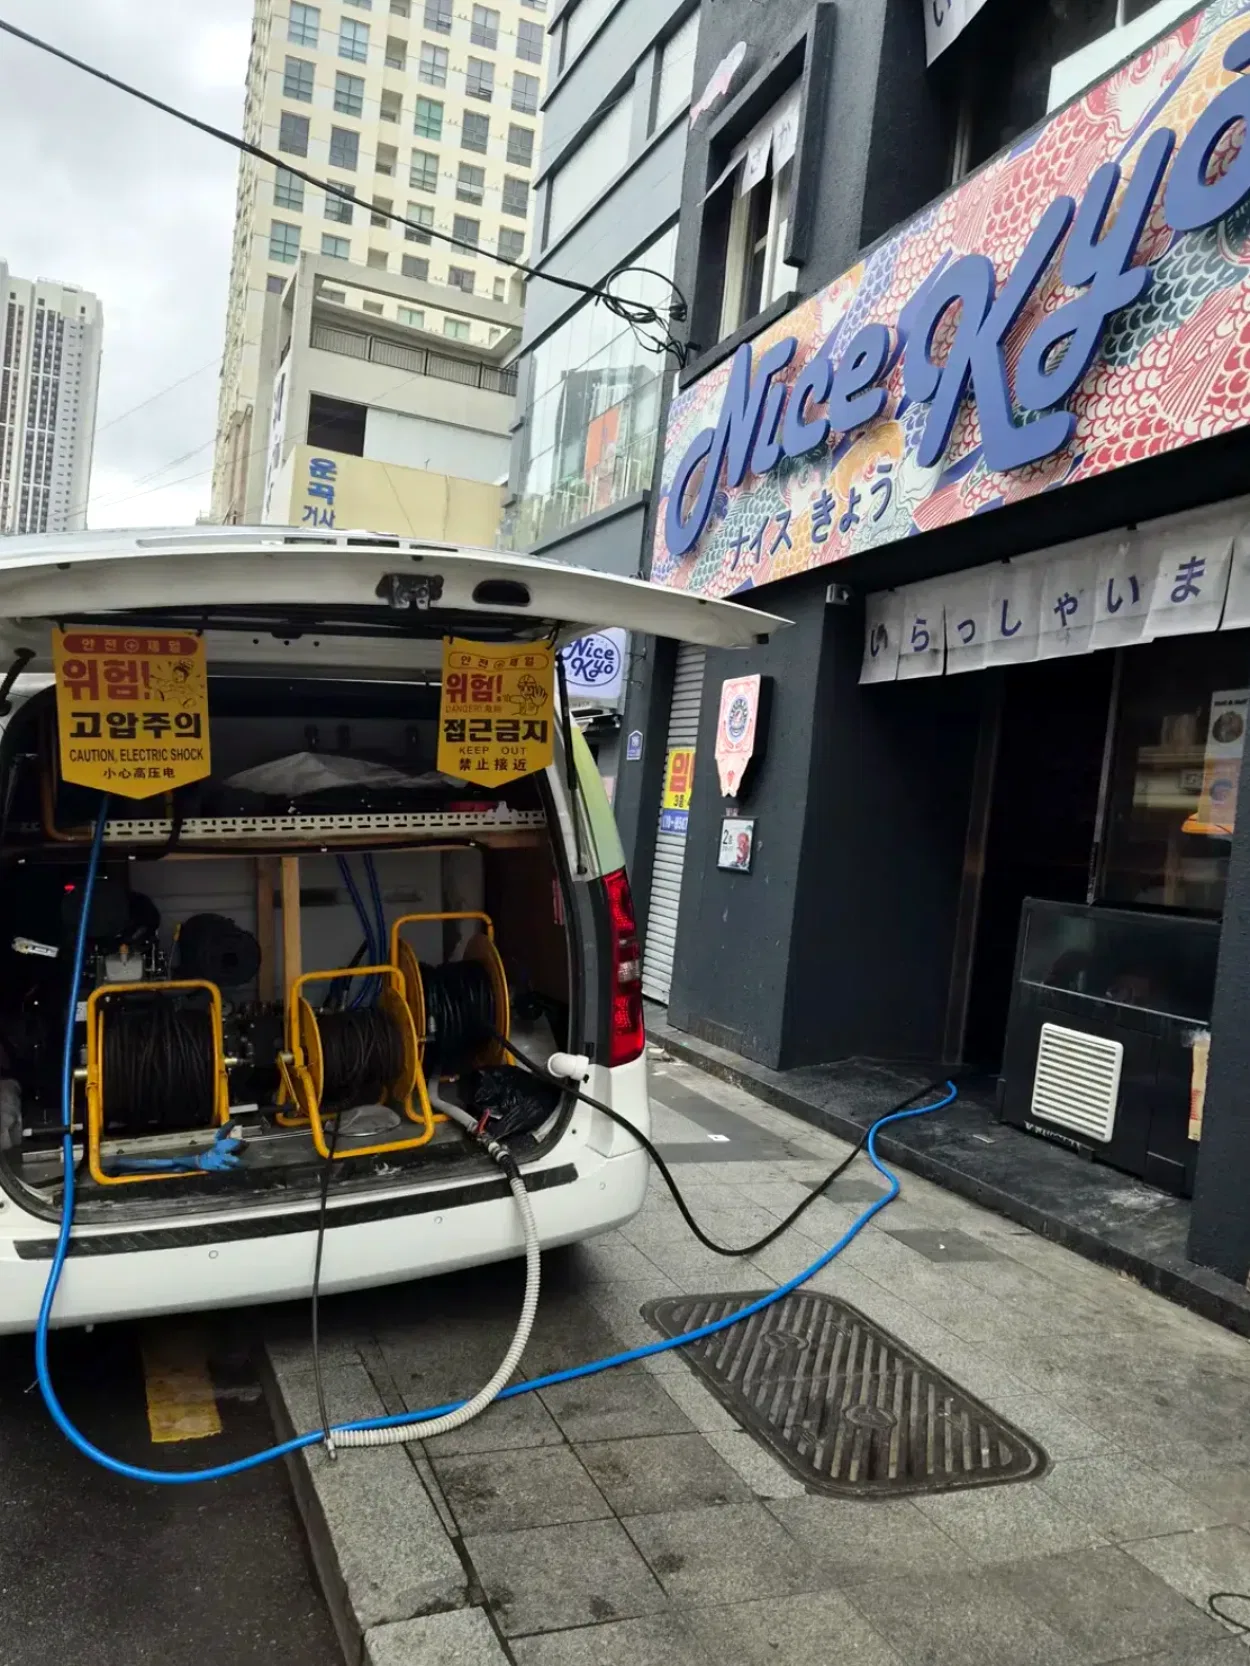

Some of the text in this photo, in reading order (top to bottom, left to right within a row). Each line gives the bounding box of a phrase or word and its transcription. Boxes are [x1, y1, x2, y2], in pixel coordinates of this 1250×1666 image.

[666, 322, 897, 556] Nice
[301, 504, 336, 529] 거사
[729, 462, 895, 573] ナイス きょう
[81, 638, 117, 652] 안전
[562, 637, 615, 661] Nice
[460, 655, 489, 669] 안전
[62, 658, 151, 701] 위험!
[446, 673, 504, 703] 위험!
[69, 711, 203, 740] 고압주의
[443, 718, 548, 744] 접근금지
[69, 747, 204, 763] CAUTION, ELECTRIC SHOCK
[459, 746, 527, 756] KEEP OUT
[103, 766, 176, 781] 小心高压电
[459, 757, 528, 772] 禁止接近
